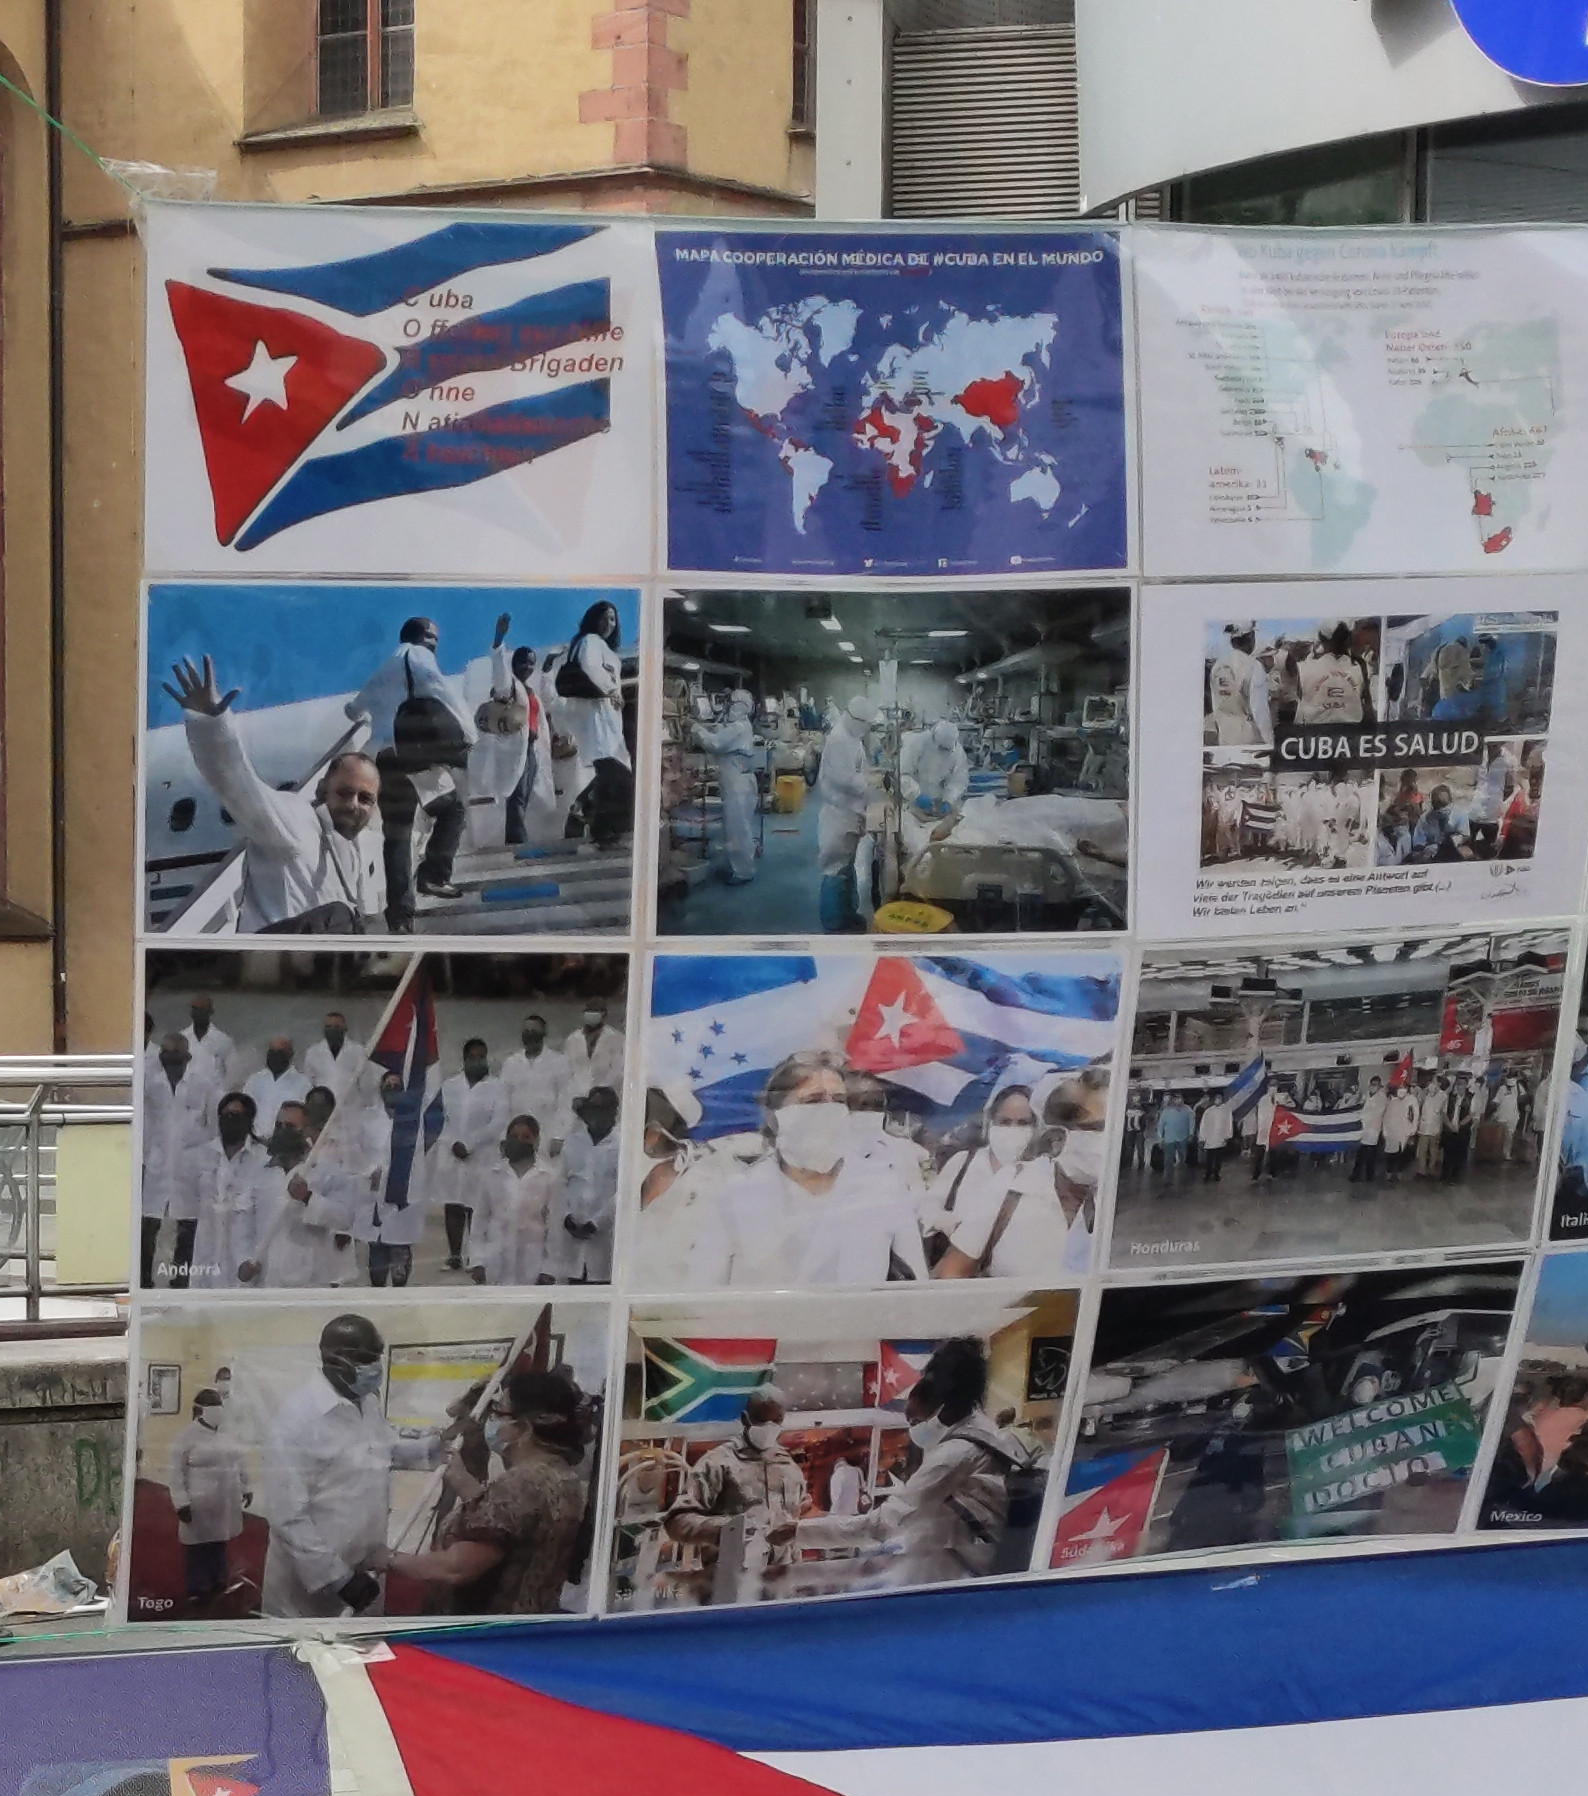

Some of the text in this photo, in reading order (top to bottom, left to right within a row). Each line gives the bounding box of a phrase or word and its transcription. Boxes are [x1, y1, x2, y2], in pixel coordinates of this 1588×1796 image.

[675, 248, 721, 263] MAPA
[722, 250, 837, 267] COOPERACIÓN
[842, 249, 905, 267] MÉDICA
[993, 253, 1014, 266] EN
[1017, 253, 1038, 266] EL
[1042, 251, 1104, 266] MUNDO
[403, 319, 421, 338] O
[402, 411, 421, 432] N
[1280, 731, 1479, 761] CUBA ES SALUD
[1130, 1238, 1202, 1257] Honduras
[157, 1261, 222, 1279] Andorra
[1290, 1384, 1460, 1448] WELCOME
[1327, 1421, 1445, 1470] CUBAN
[1490, 1508, 1543, 1524] Mexico
[138, 1595, 175, 1613] Togo
